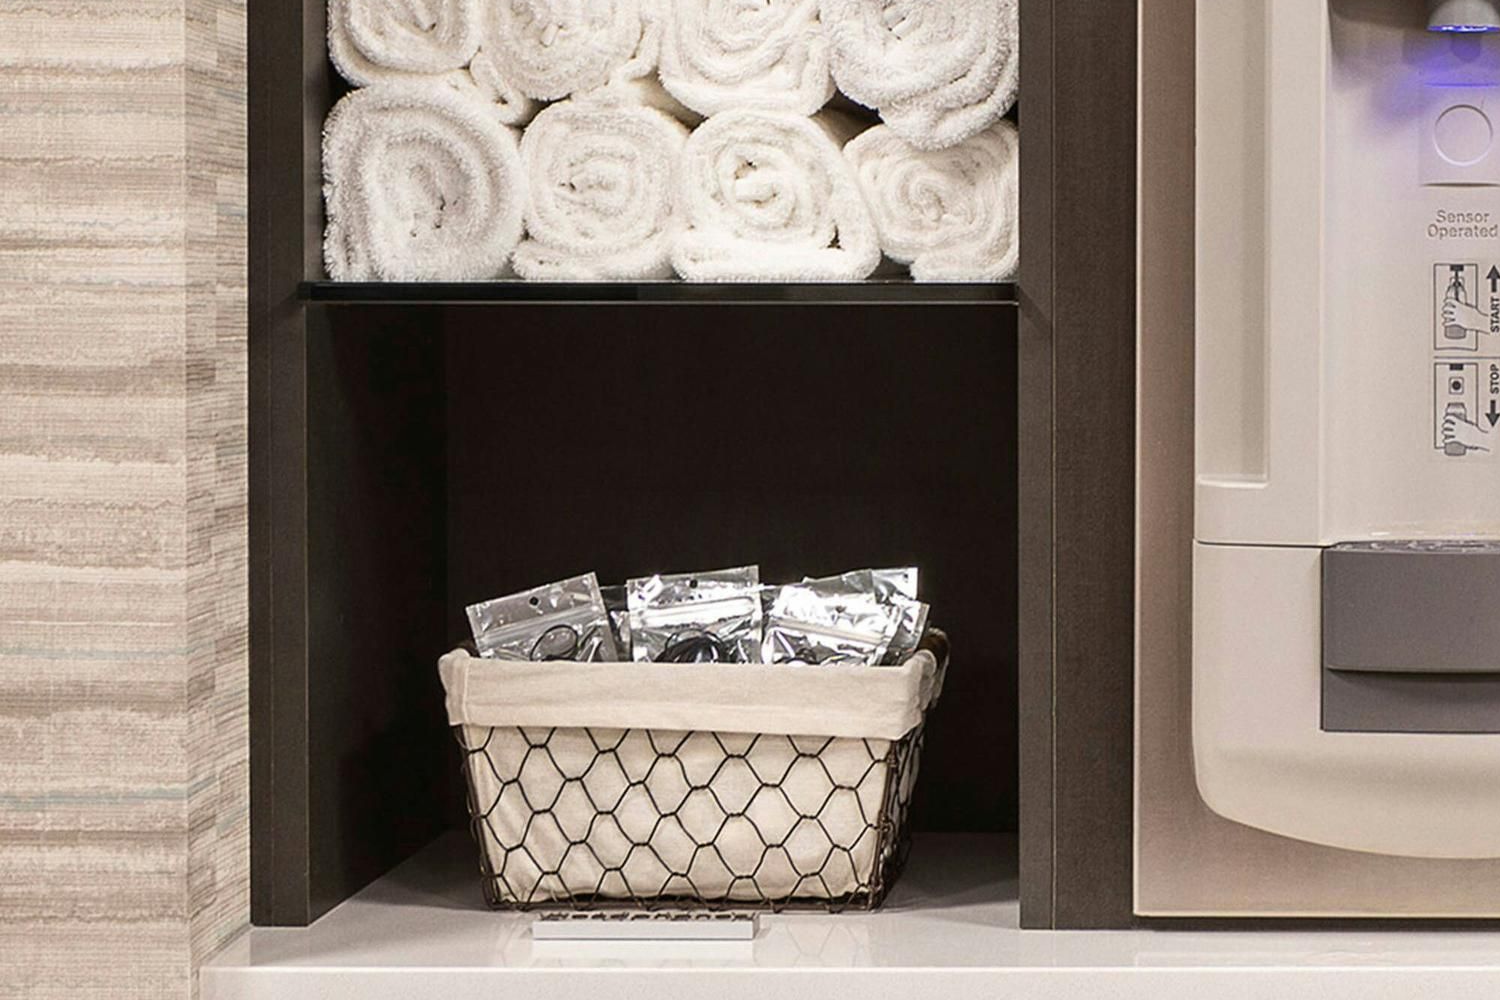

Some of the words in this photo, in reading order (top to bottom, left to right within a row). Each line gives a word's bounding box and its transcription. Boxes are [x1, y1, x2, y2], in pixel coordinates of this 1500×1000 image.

[1436, 209, 1490, 223] Sensor
[1427, 223, 1498, 240] Operated
[1490, 296, 1500, 333] START
[1489, 364, 1500, 394] STOP
